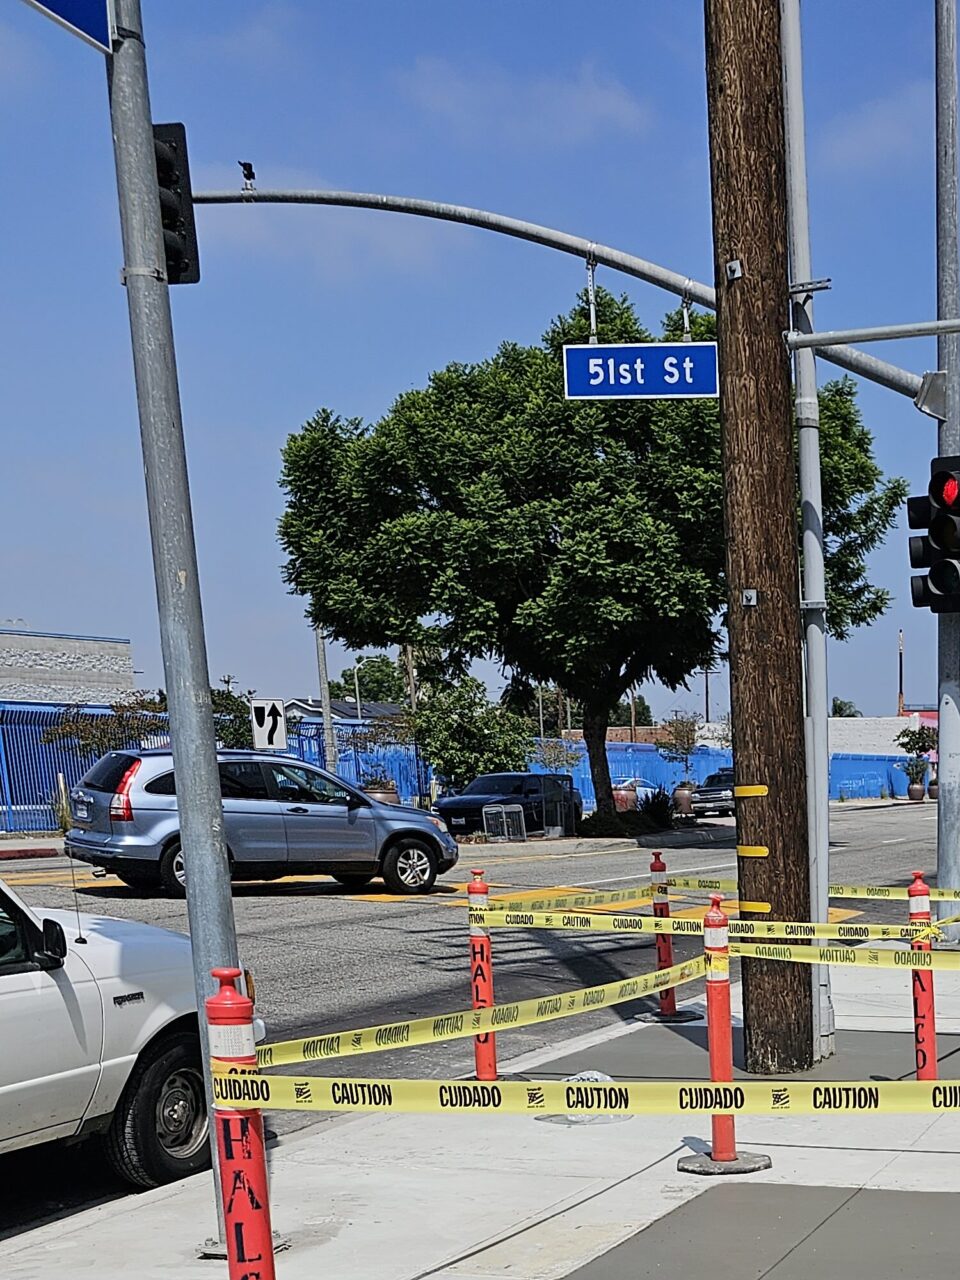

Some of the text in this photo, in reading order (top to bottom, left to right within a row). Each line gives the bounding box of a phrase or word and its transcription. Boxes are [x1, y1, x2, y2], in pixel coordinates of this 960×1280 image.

[588, 356, 694, 385] 51st St
[505, 914, 534, 925] CUIDADO
[562, 916, 591, 928] CAUTION
[612, 918, 643, 930] CUIDADO
[672, 920, 702, 932] CAUTION
[728, 923, 755, 934] UIDADO
[785, 925, 815, 937] CAUTION
[838, 926, 869, 938] CUIDADO
[213, 1077, 271, 1102] CUIDADO
[331, 1082, 393, 1106] CAUTION
[439, 1084, 502, 1107] CUIDADO
[565, 1086, 629, 1110] CAUTION
[679, 1087, 745, 1110] CUIDADO
[813, 1087, 879, 1110] CAUTION
